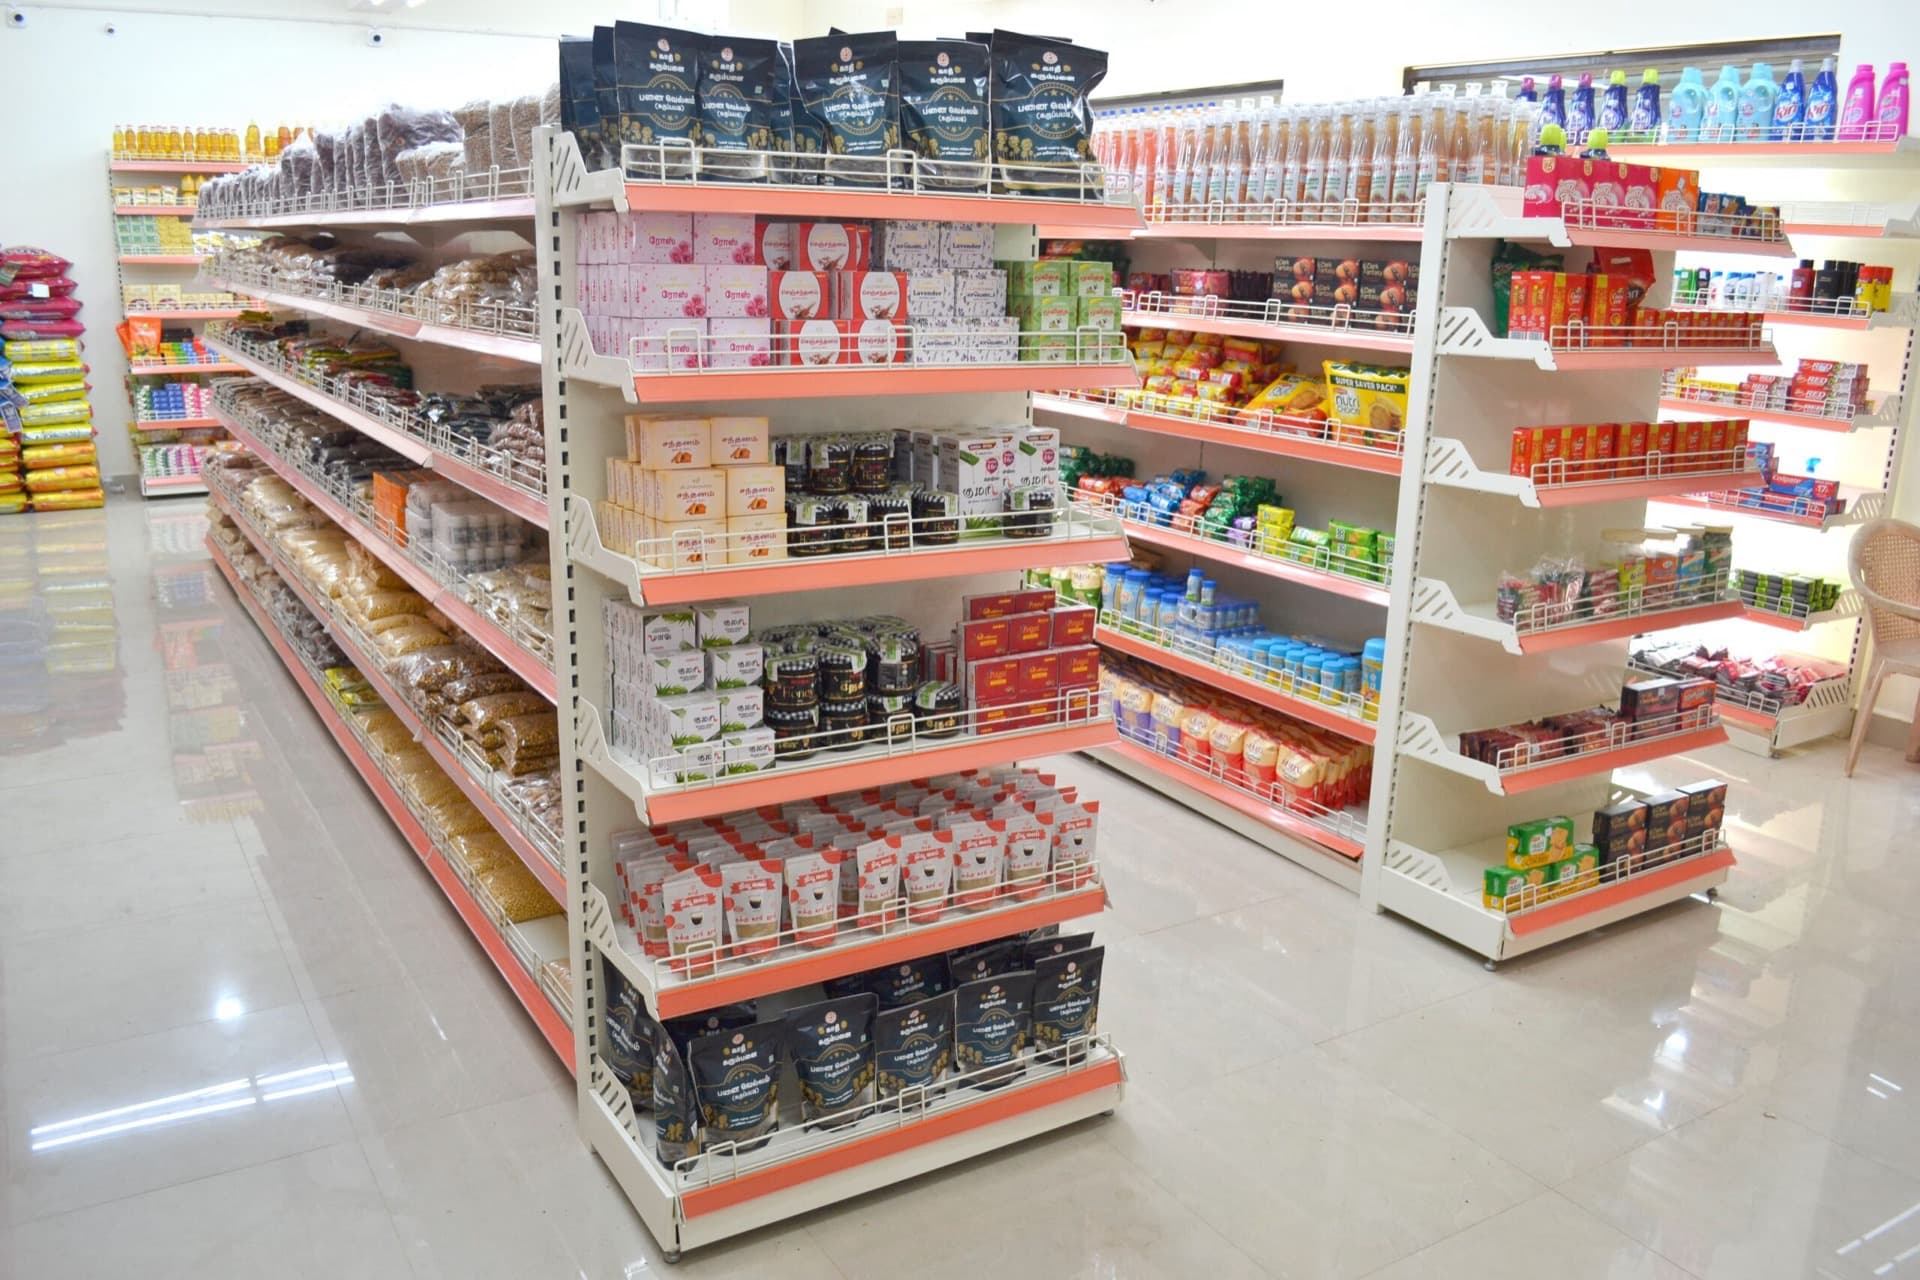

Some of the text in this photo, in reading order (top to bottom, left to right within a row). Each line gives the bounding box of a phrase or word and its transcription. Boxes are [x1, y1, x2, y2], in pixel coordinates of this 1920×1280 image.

[1776, 103, 1798, 120] Rin
[1807, 102, 1831, 119] Rin
[1812, 363, 1833, 372] RED
[1335, 376, 1354, 386] SUPER
[1355, 379, 1375, 389] SAVER
[1807, 376, 1828, 384] RED
[1806, 391, 1826, 399] RED
[1772, 474, 1801, 483] Colgate
